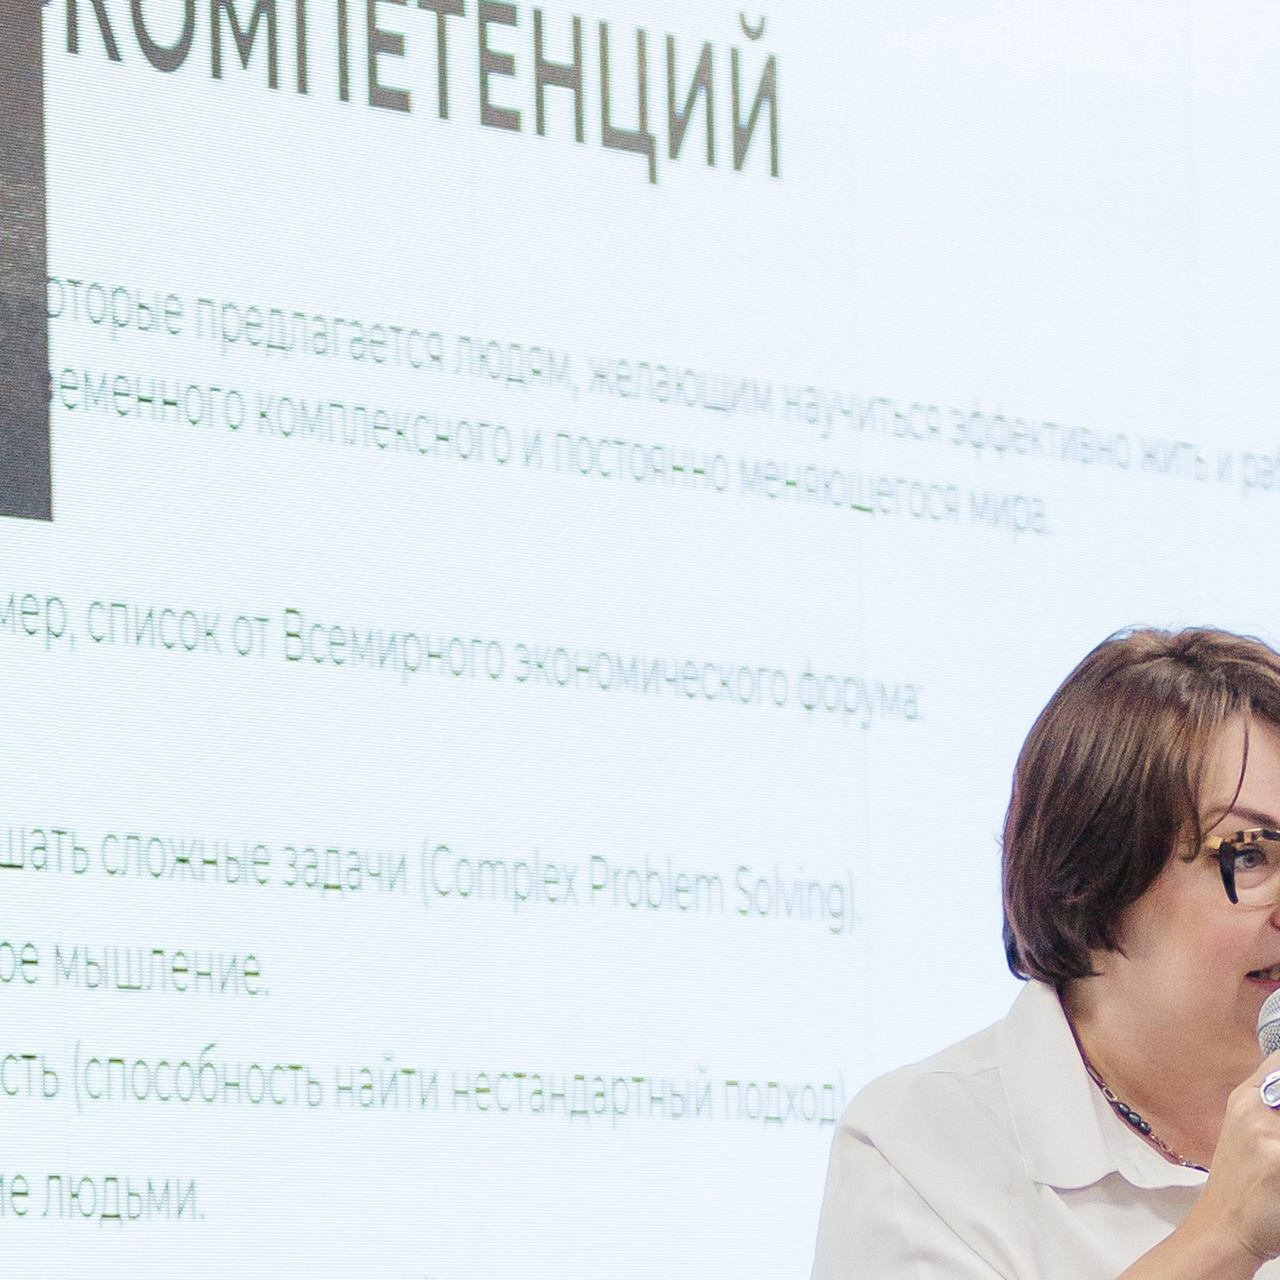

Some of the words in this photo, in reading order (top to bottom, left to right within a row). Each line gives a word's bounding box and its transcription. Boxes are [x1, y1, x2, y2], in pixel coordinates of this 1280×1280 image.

[197, 297, 443, 371] предлагается
[455, 336, 579, 400] людям,
[588, 354, 773, 417] желающим
[785, 382, 941, 440] научиться
[1140, 437, 1208, 482] жить
[1217, 449, 1233, 482] и
[49, 368, 245, 431] еменного
[258, 393, 512, 465] комплексного
[524, 429, 543, 469] и
[556, 433, 729, 492] постоянно
[741, 457, 959, 525] меняющегося
[87, 600, 221, 654] список
[233, 615, 269, 658] от
[285, 607, 504, 684] Всемирного
[515, 643, 788, 706] экономического
[102, 834, 270, 885] сложные
[284, 846, 406, 898] задачи
[422, 839, 578, 914] (Complex
[590, 854, 725, 912] Problem
[56, 944, 270, 996] мышление.
[1, 1054, 58, 1098] сть
[75, 1039, 322, 1115] (способность
[336, 1052, 438, 1108] найти
[454, 1065, 712, 1128] нестандартный
[42, 1173, 206, 1228] людьми.
